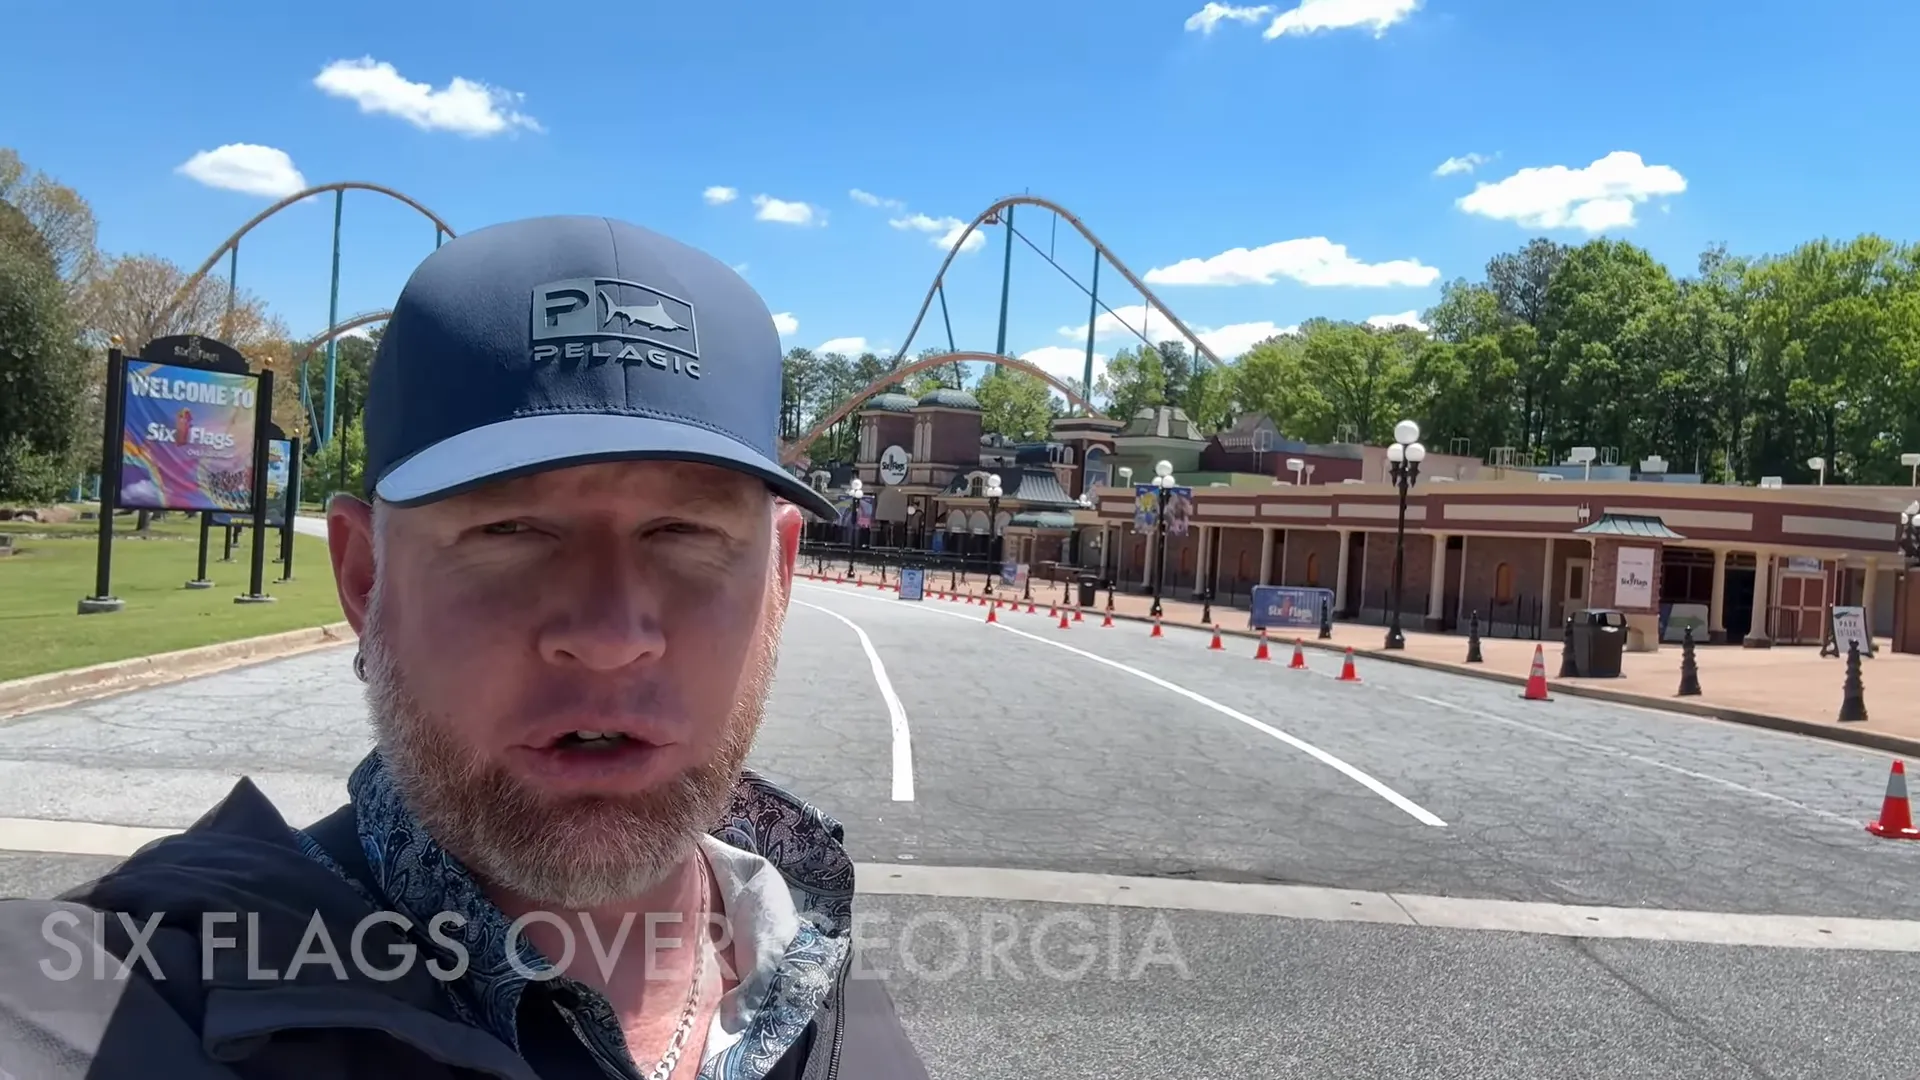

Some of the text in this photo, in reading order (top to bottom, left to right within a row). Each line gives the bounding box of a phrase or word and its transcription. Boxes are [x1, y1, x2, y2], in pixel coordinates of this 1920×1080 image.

[544, 289, 590, 328] P
[534, 342, 700, 379] PELAGIC
[128, 373, 255, 408] WELCOME TO
[146, 421, 235, 450] Six Flags
